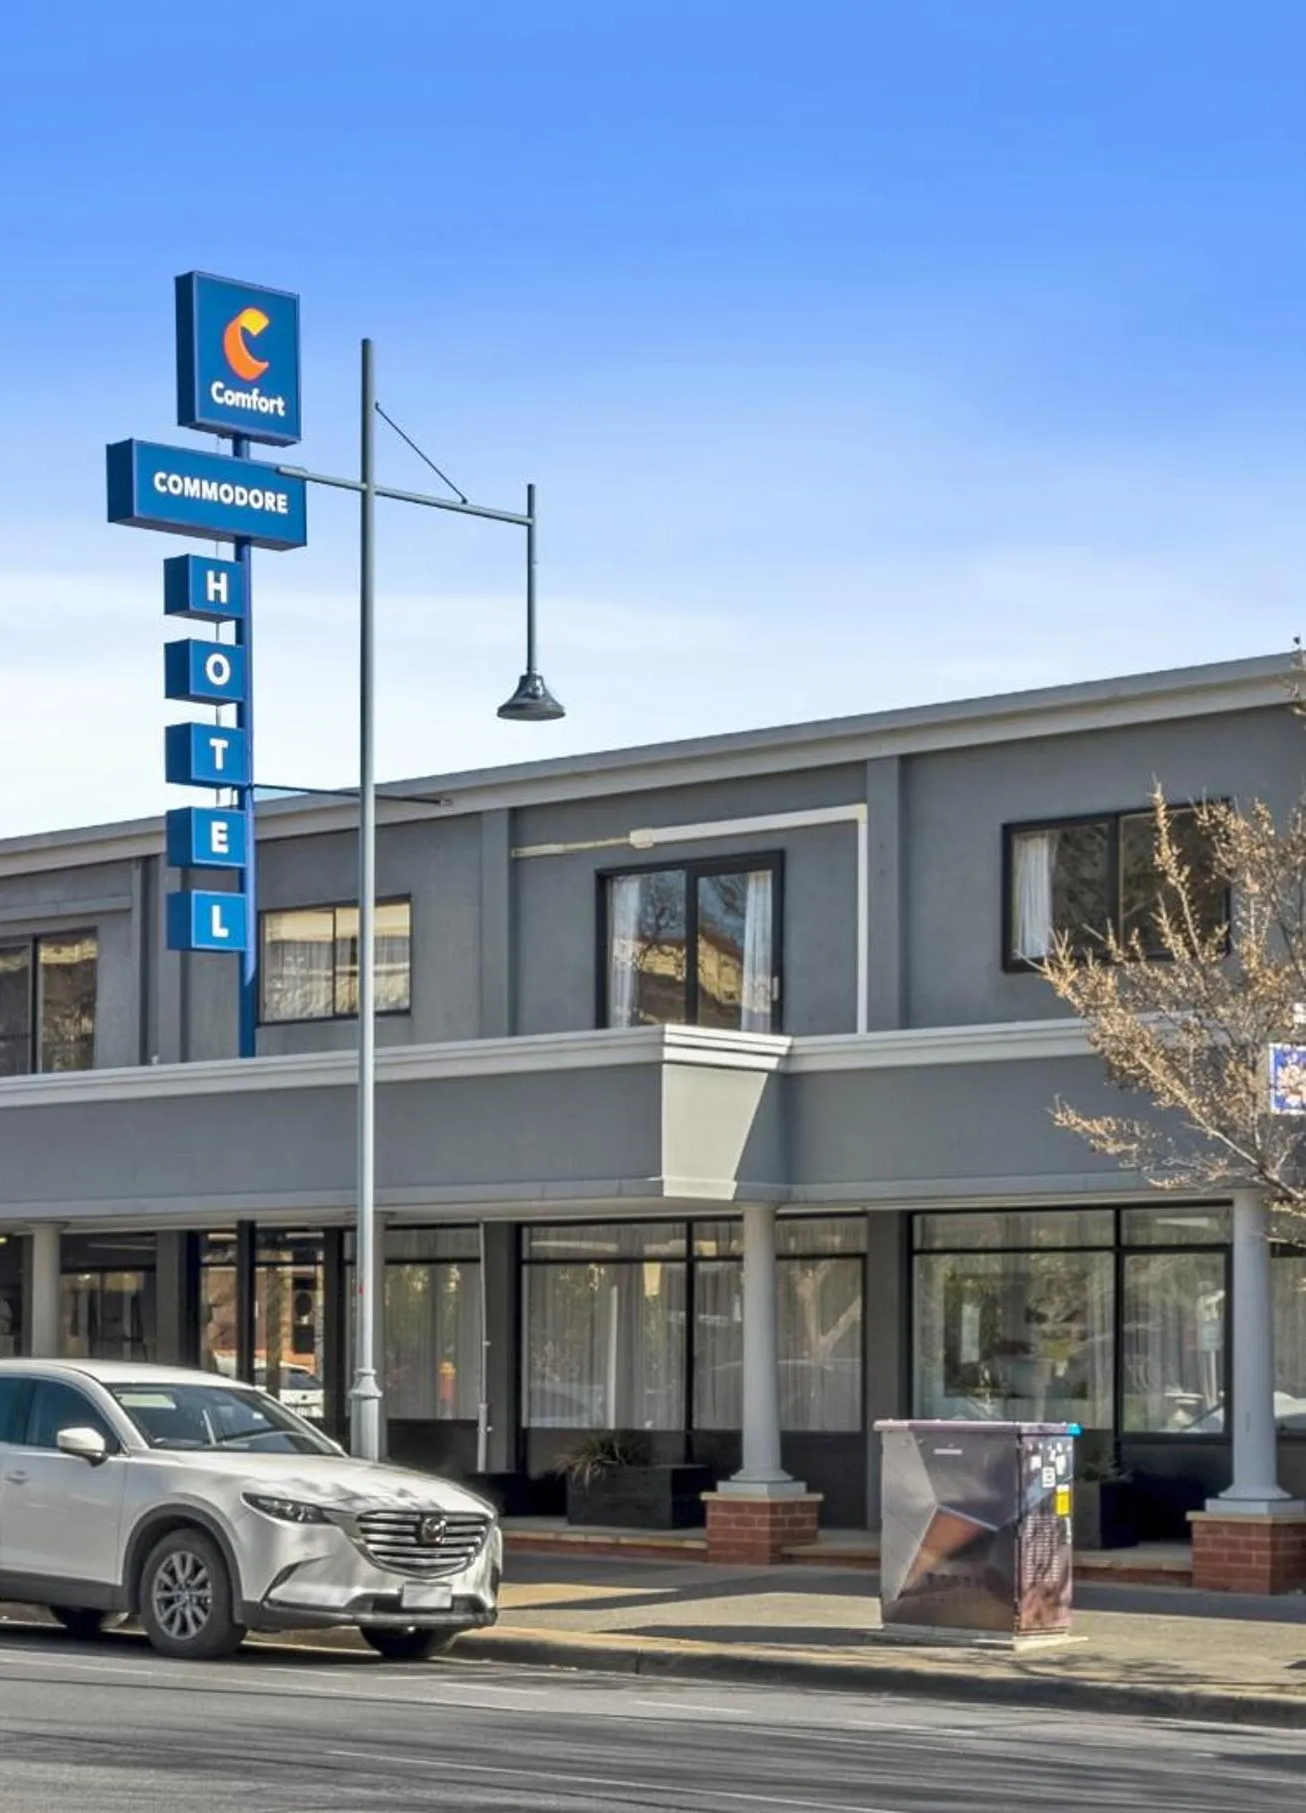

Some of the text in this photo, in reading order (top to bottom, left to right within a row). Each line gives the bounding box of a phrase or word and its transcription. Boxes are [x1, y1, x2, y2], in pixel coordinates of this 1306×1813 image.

[211, 381, 286, 417] Comfort
[153, 471, 289, 514] COMMODORE
[205, 570, 231, 939] HOTEL
